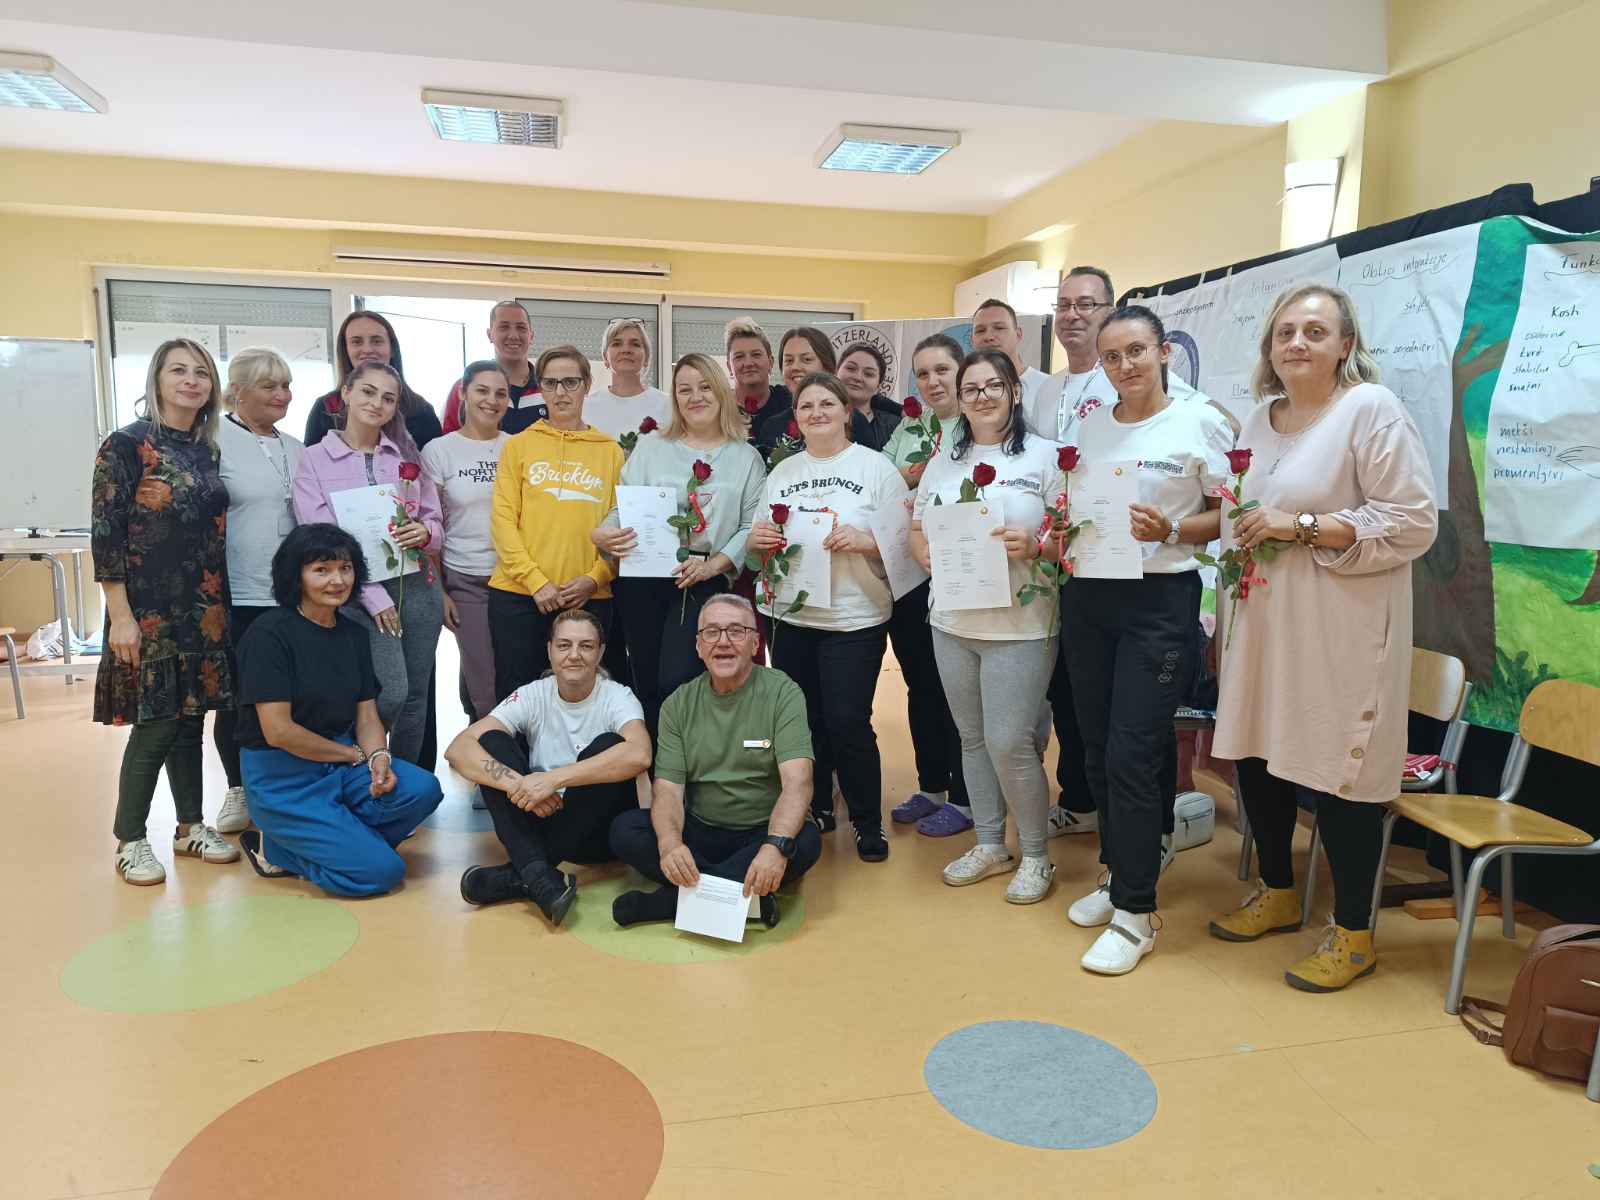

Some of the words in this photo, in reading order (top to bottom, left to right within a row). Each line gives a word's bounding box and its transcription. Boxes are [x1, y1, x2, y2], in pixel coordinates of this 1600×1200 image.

[1560, 253, 1600, 269] Funkc
[832, 329, 893, 366] ITZERLAND
[878, 375, 894, 397] SSE
[1232, 384, 1250, 397] Elem
[477, 460, 499, 469] THE
[473, 475, 496, 483] FAC
[529, 461, 604, 491] Brooklyn
[811, 476, 864, 495] BRUNCH
